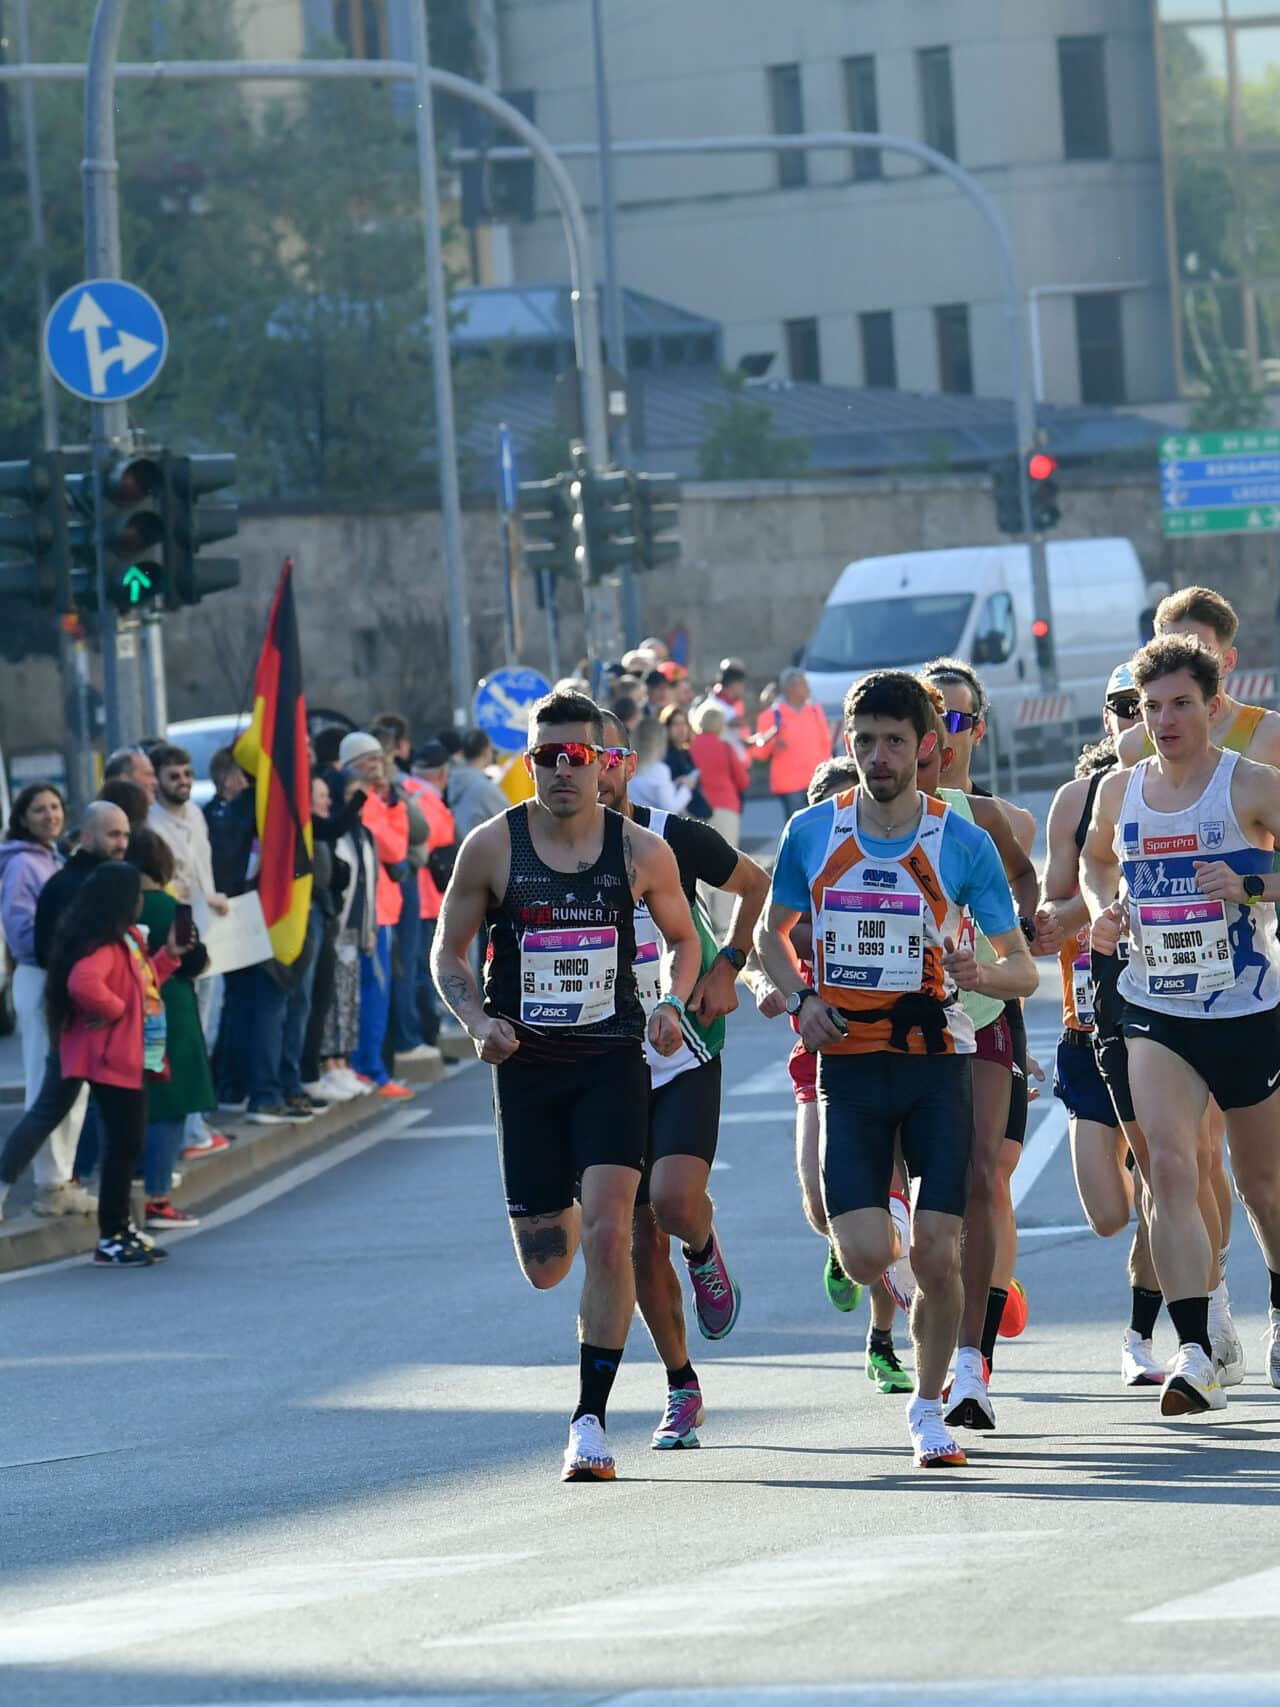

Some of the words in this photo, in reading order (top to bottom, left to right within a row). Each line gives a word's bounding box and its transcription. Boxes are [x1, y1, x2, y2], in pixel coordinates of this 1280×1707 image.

[1146, 838, 1194, 852] SportPro
[857, 919, 886, 939] FABIO
[1162, 930, 1203, 950] ROBERTO
[858, 942, 884, 956] 9393
[1172, 951, 1197, 965] 3883
[554, 958, 588, 976] ENRICO
[842, 969, 868, 980] asics
[560, 980, 582, 992] 7810
[1163, 979, 1185, 989] asics
[542, 1008, 568, 1017] asics
